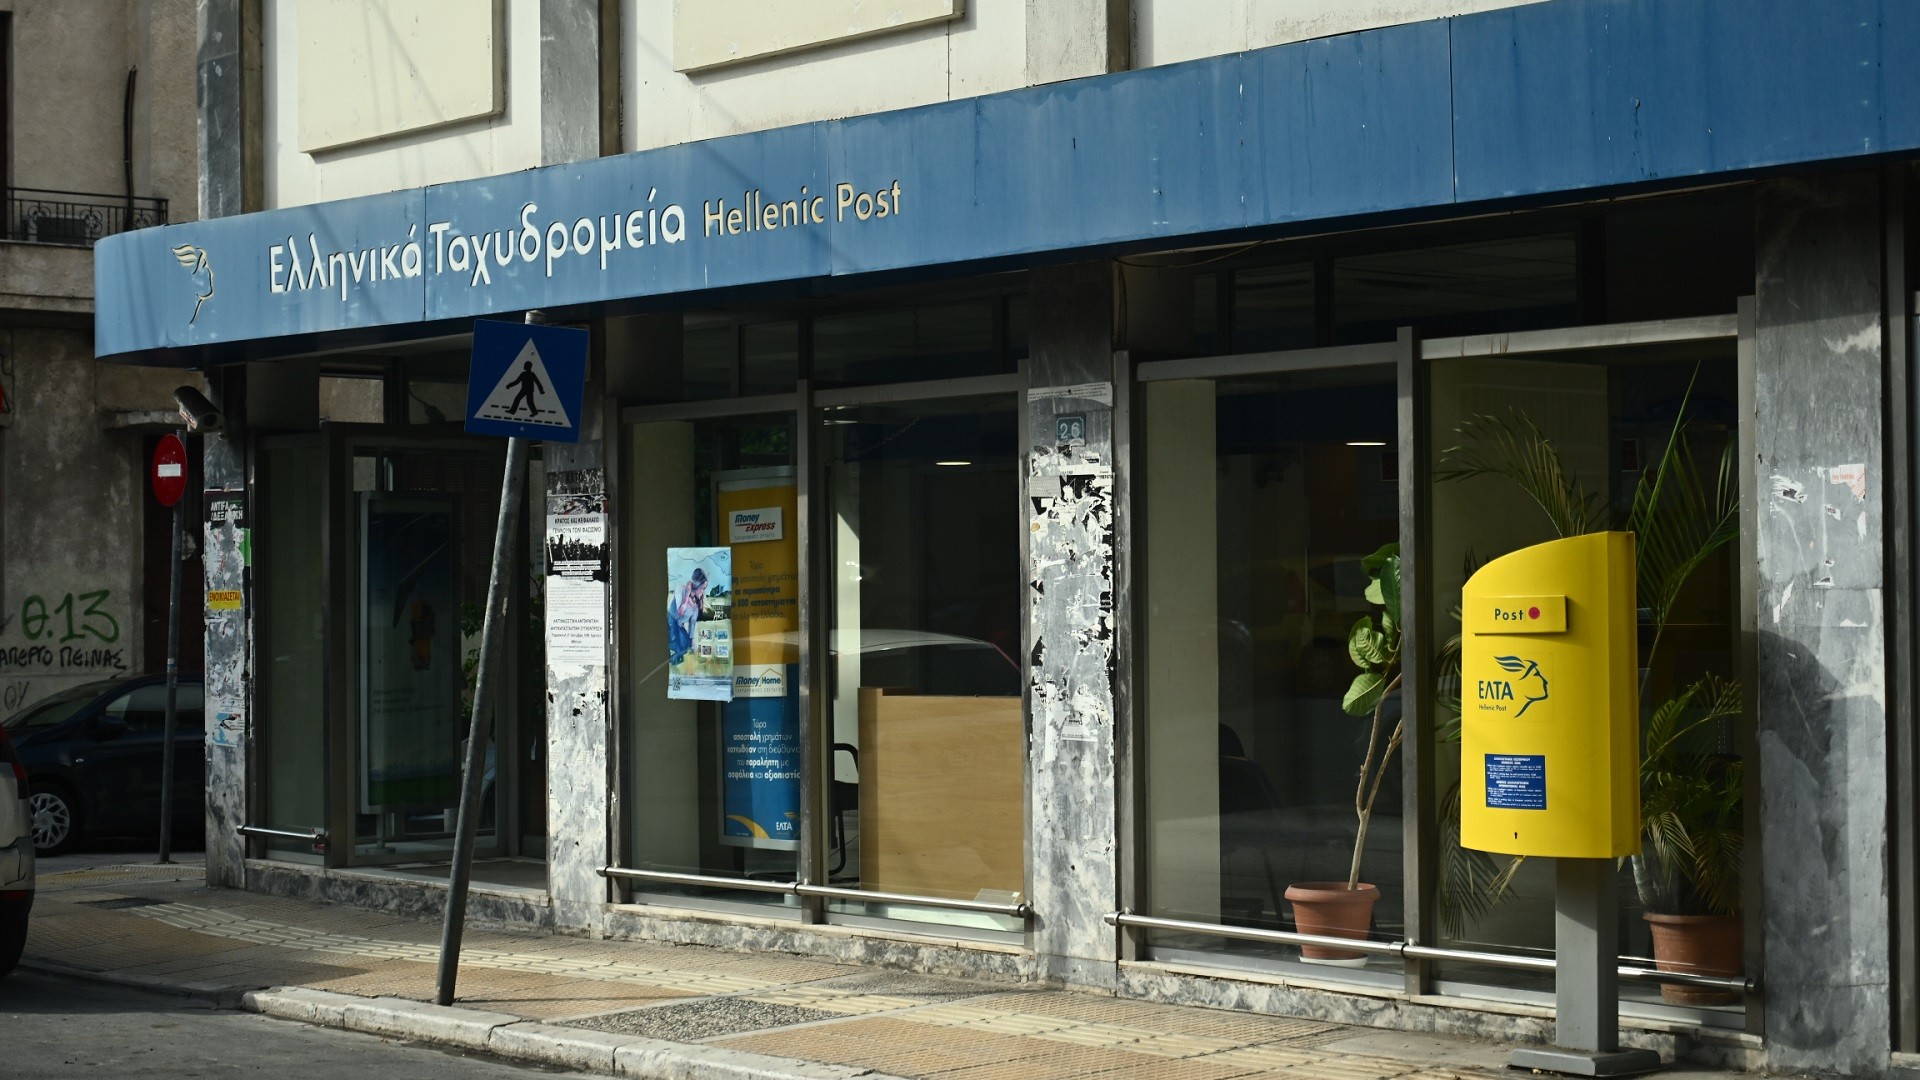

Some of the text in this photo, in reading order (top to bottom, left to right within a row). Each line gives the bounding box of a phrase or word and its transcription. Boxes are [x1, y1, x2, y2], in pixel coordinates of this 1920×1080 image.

[704, 180, 901, 238] Hellenic Post
[269, 187, 686, 301] Ελληνικά Ταχυδρομεία
[1060, 422, 1080, 439] 26
[734, 513, 760, 524] Money
[745, 522, 776, 533] Express
[1494, 608, 1524, 621] Post
[735, 676, 761, 687] Money
[761, 676, 782, 685] Home
[1478, 680, 1514, 701] ΕΛΤΑ
[1496, 704, 1507, 712] Post
[752, 718, 767, 730] Τώρα
[775, 821, 793, 831] ΕΛΤΑ
